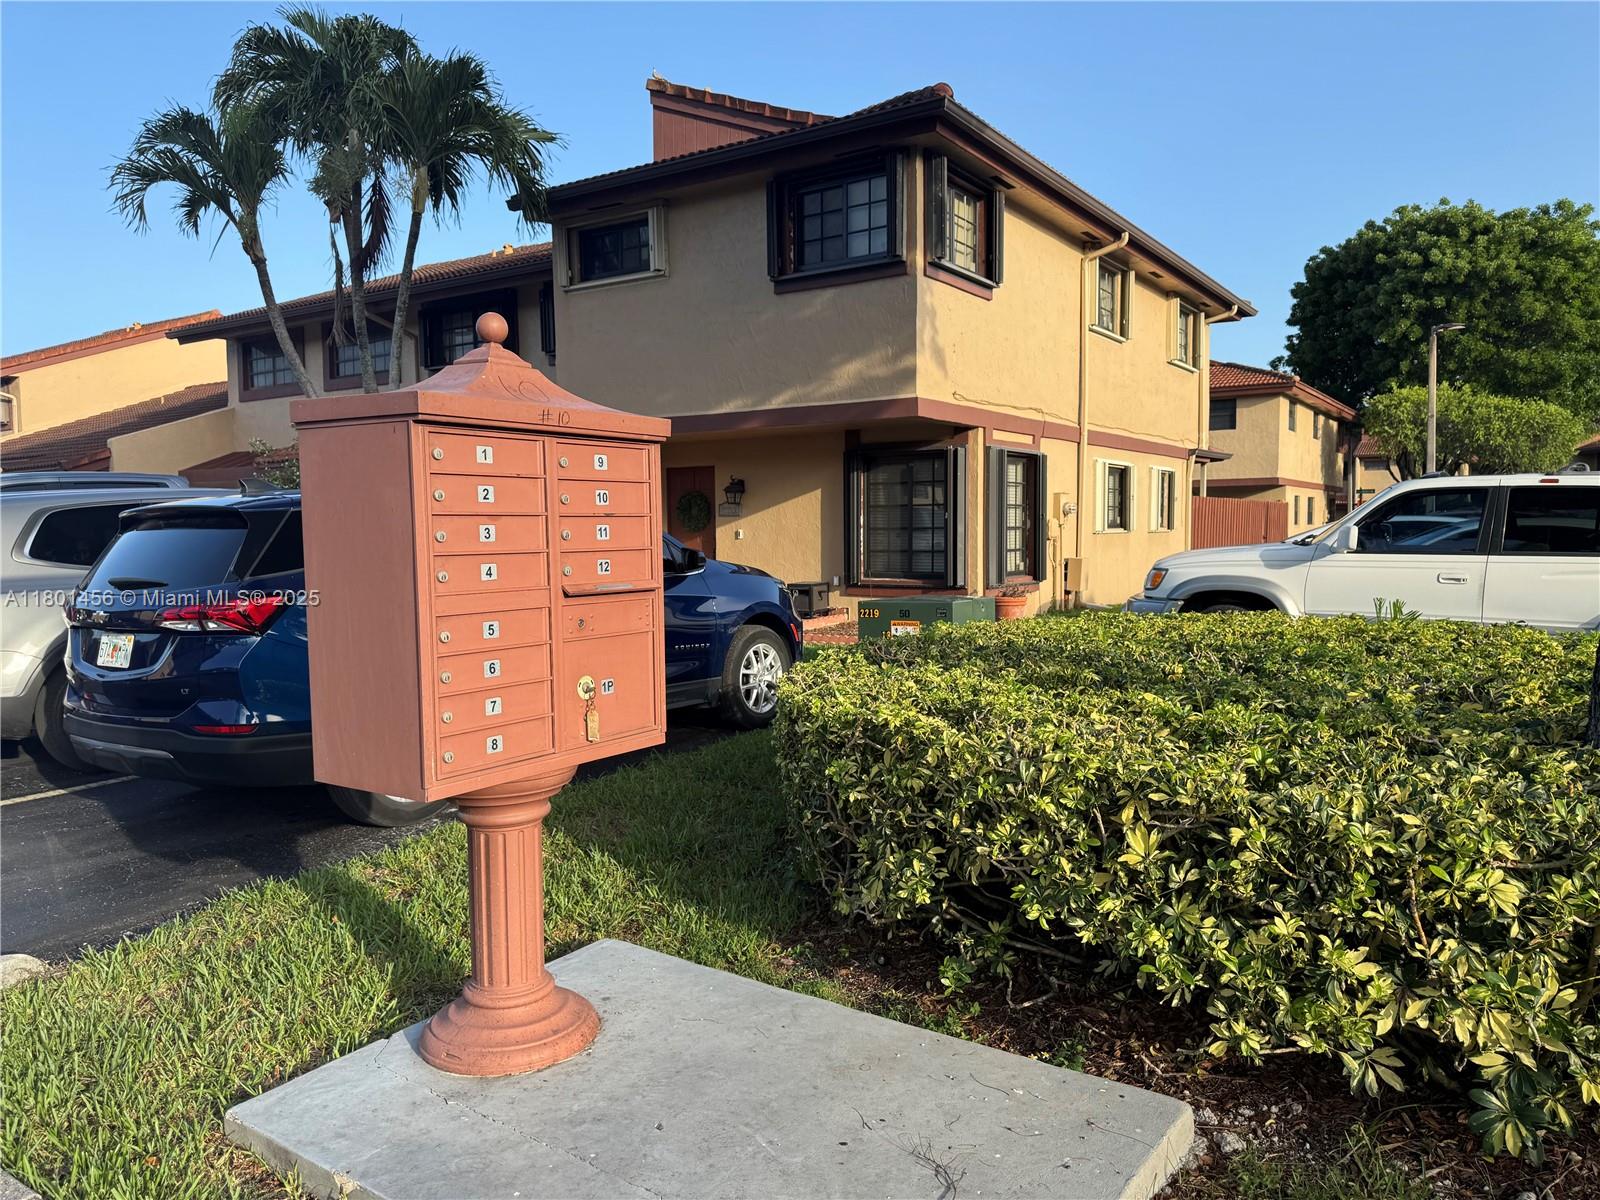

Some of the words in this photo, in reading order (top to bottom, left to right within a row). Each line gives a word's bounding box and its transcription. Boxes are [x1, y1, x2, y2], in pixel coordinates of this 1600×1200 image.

[481, 449, 488, 461] 1
[597, 457, 605, 468] 9
[482, 488, 490, 501] 2
[597, 492, 608, 504] 10
[483, 527, 491, 540] 3
[597, 527, 608, 538] 11
[485, 566, 493, 578] 4
[598, 561, 610, 573] 12
[860, 609, 879, 617] 2219
[487, 624, 495, 636] 5
[489, 662, 496, 675] 6
[602, 681, 614, 693] 1P
[490, 700, 497, 712] 7
[491, 738, 498, 751] 8
